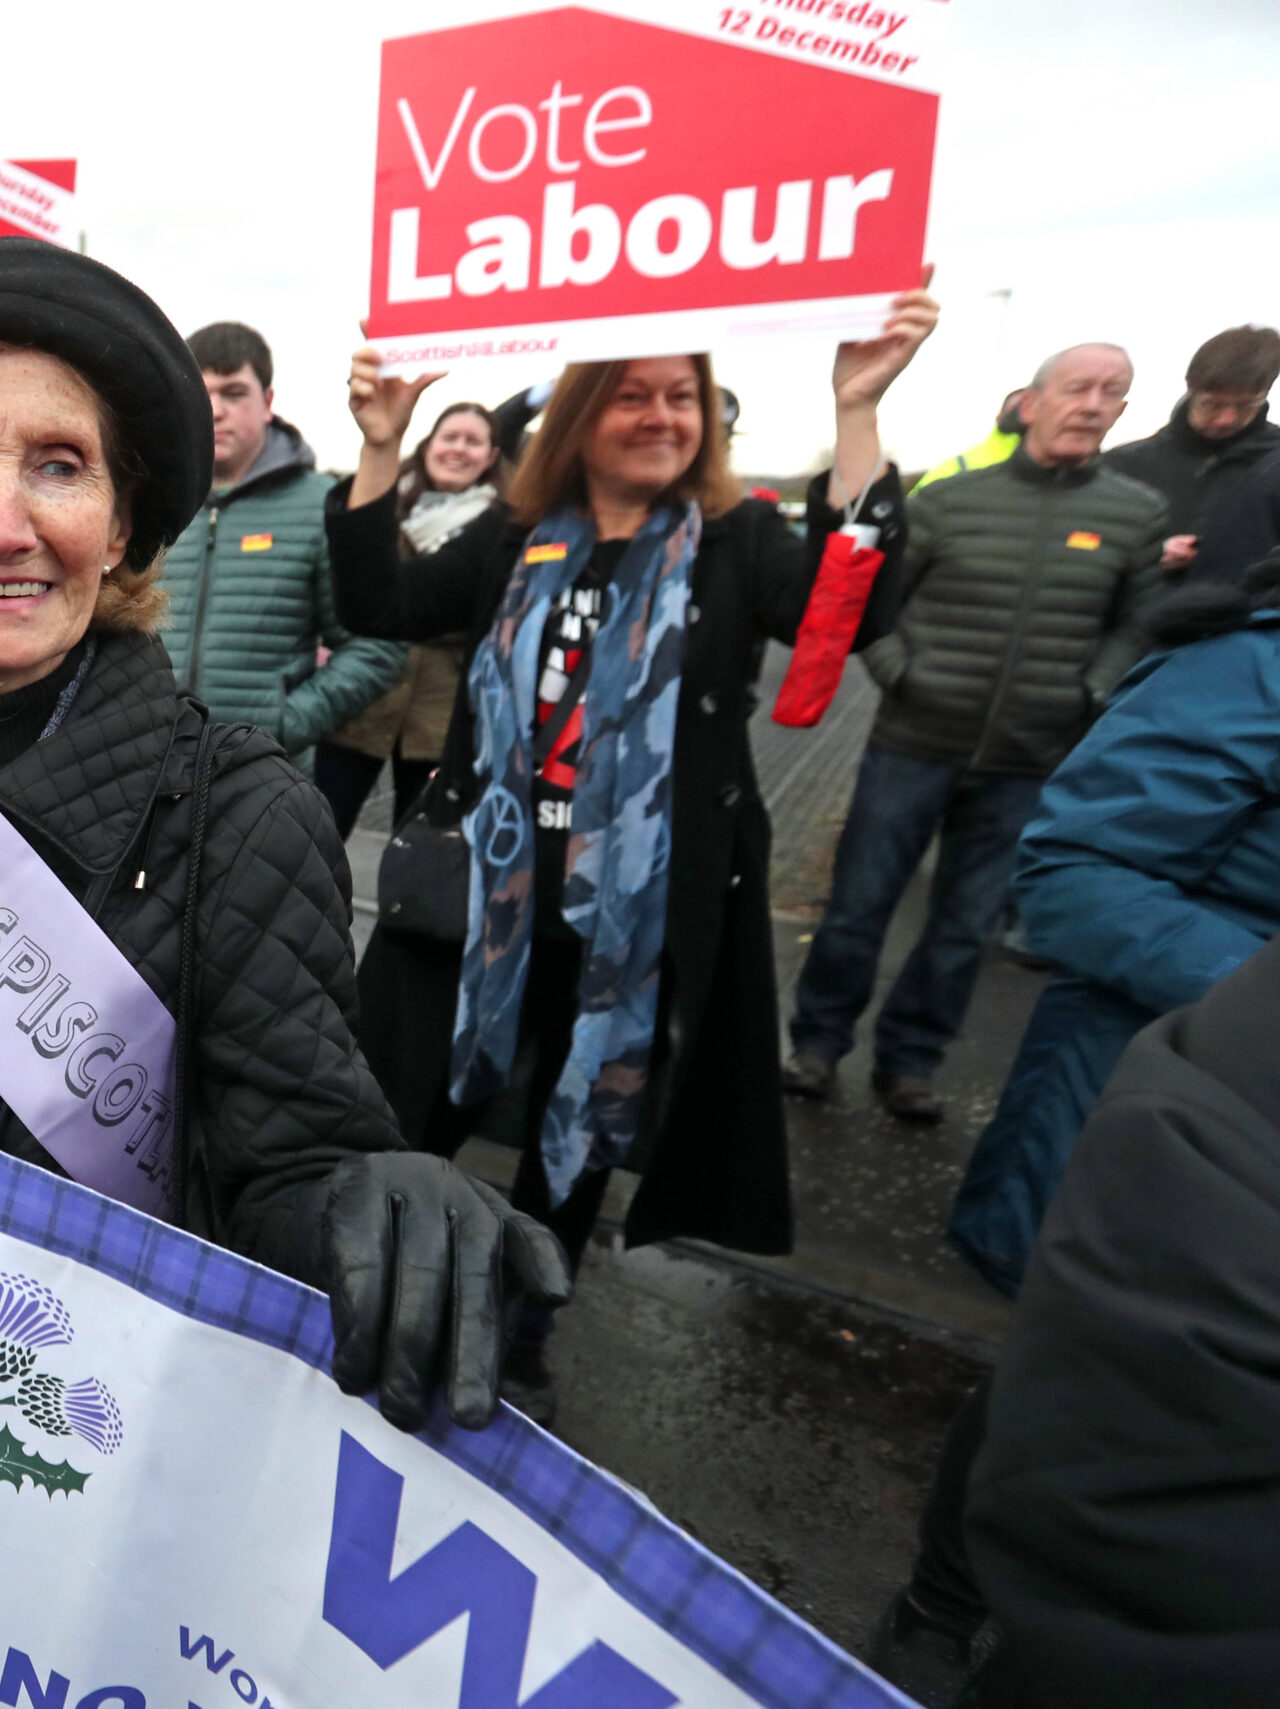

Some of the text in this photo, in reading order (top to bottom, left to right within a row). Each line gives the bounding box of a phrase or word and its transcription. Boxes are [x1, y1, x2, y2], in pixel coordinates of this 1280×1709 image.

[719, 7, 920, 75] 12 December
[397, 80, 653, 191] Vote
[387, 169, 895, 304] Labour
